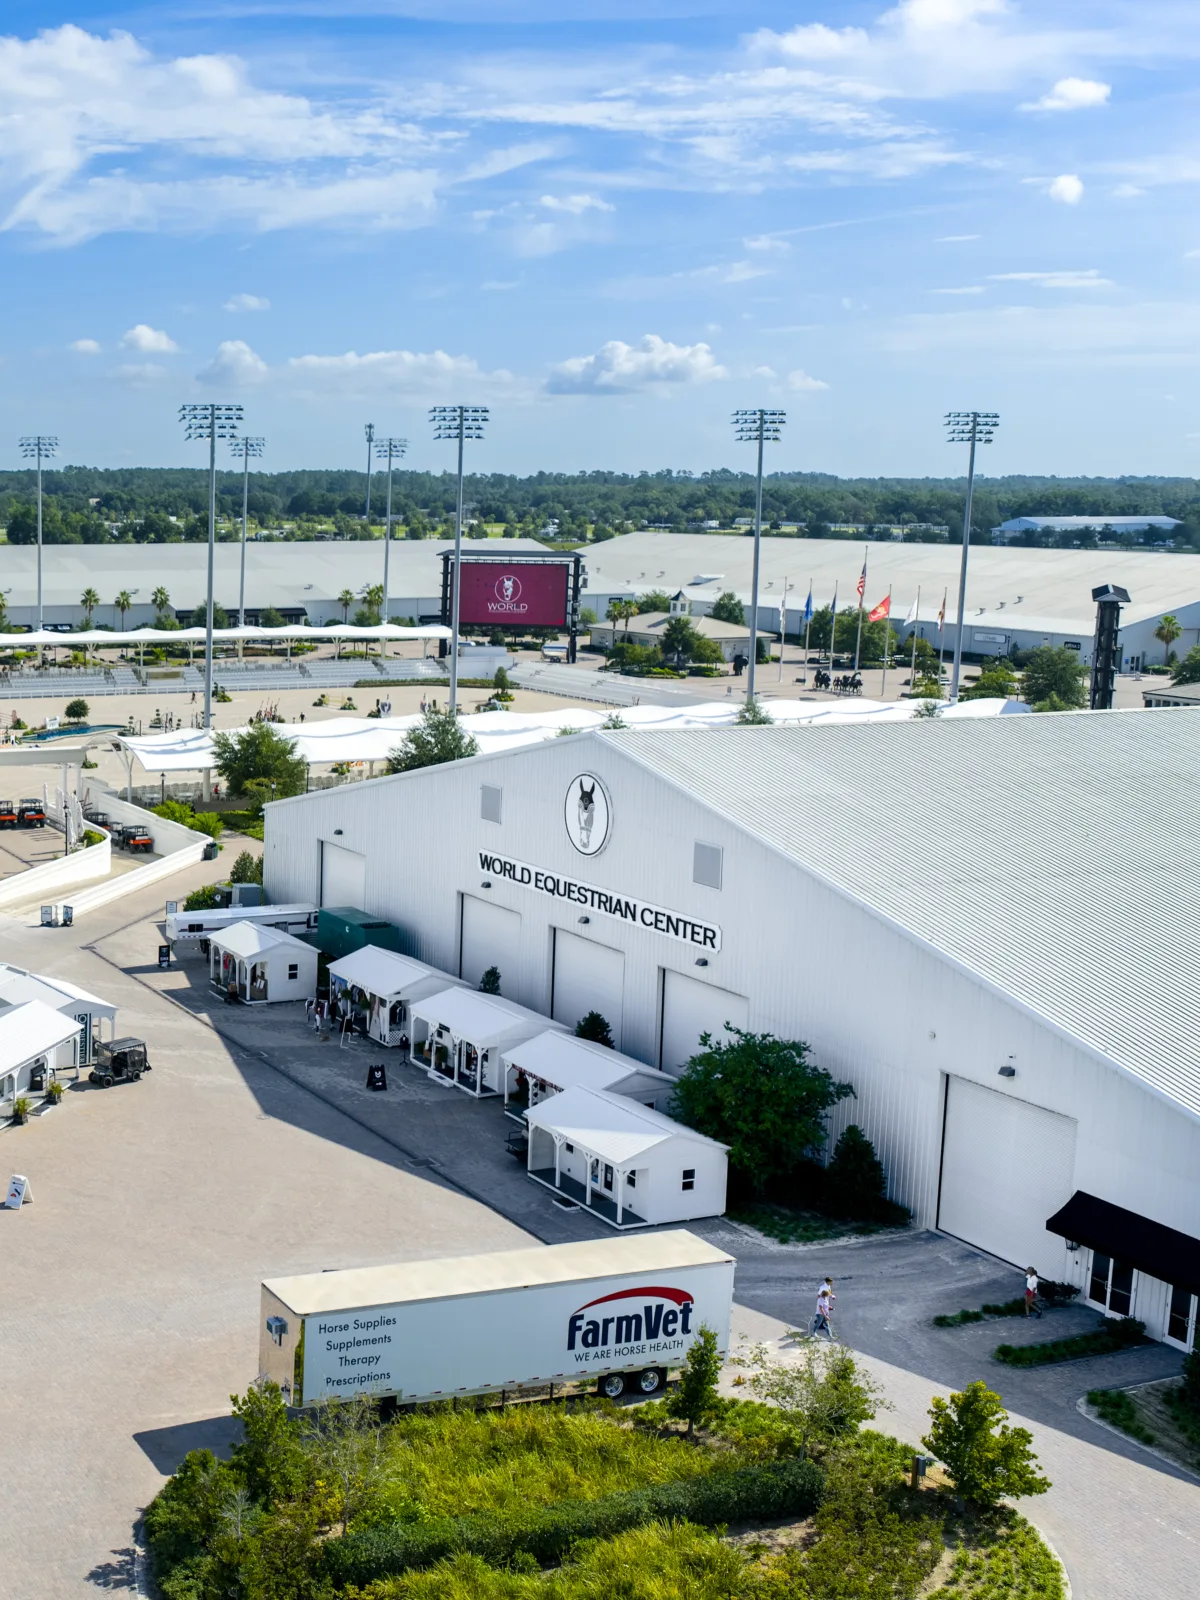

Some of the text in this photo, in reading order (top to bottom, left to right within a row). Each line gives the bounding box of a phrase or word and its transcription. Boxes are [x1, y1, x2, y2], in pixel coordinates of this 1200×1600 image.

[488, 602, 528, 610] WORLD
[479, 852, 717, 949] WORLD EQUESTRIAN CENTER
[319, 1315, 397, 1334] Horse Supplies
[567, 1302, 693, 1351] FarmVet
[326, 1334, 392, 1352] Supplements
[574, 1340, 684, 1362] WE ARE HORSE HEALTH
[339, 1354, 381, 1367] Therapy
[326, 1371, 391, 1387] Prescriptions
